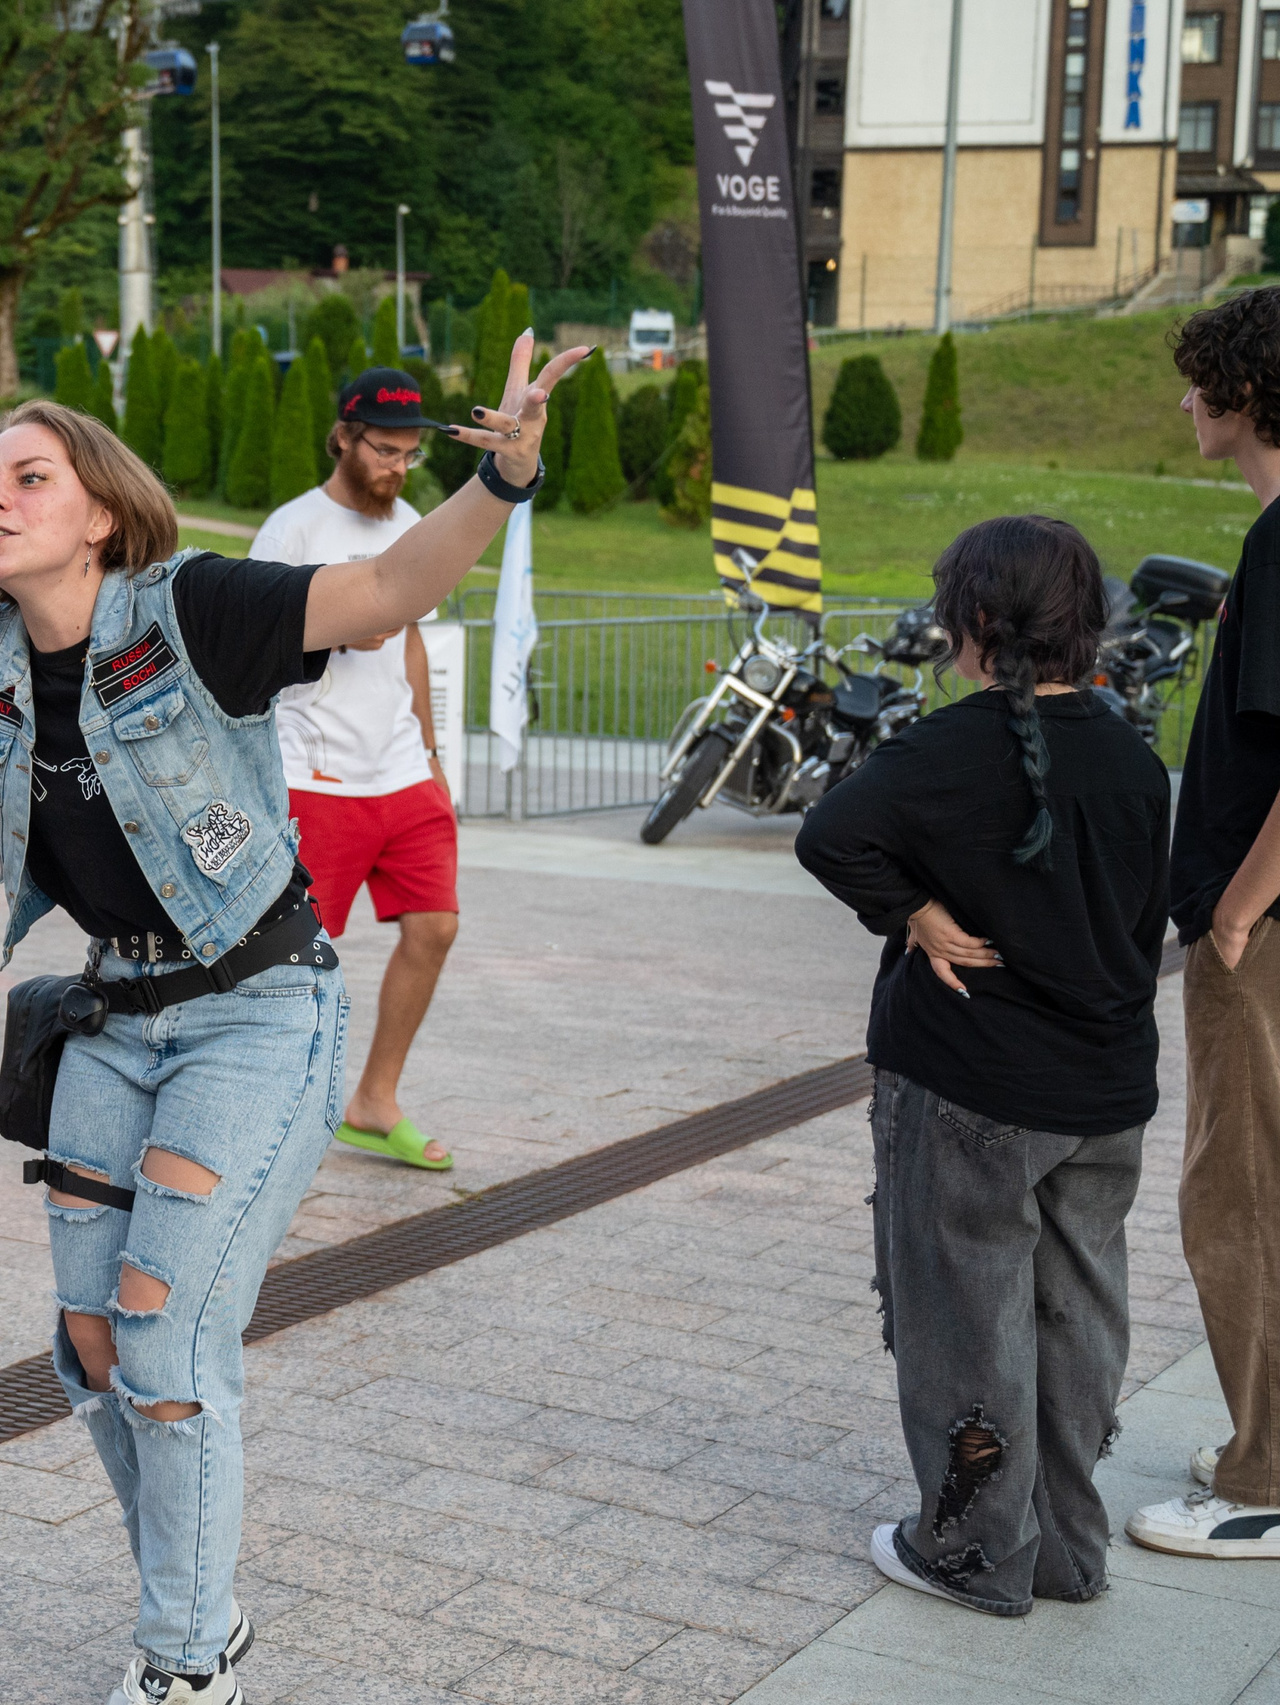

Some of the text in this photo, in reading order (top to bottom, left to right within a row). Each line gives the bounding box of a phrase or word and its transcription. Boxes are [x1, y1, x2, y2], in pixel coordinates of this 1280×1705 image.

[716, 173, 781, 201] VOGE
[111, 640, 151, 672] RUSSIA
[122, 662, 157, 691] SOCHI
[201, 817, 243, 858] WORLD
